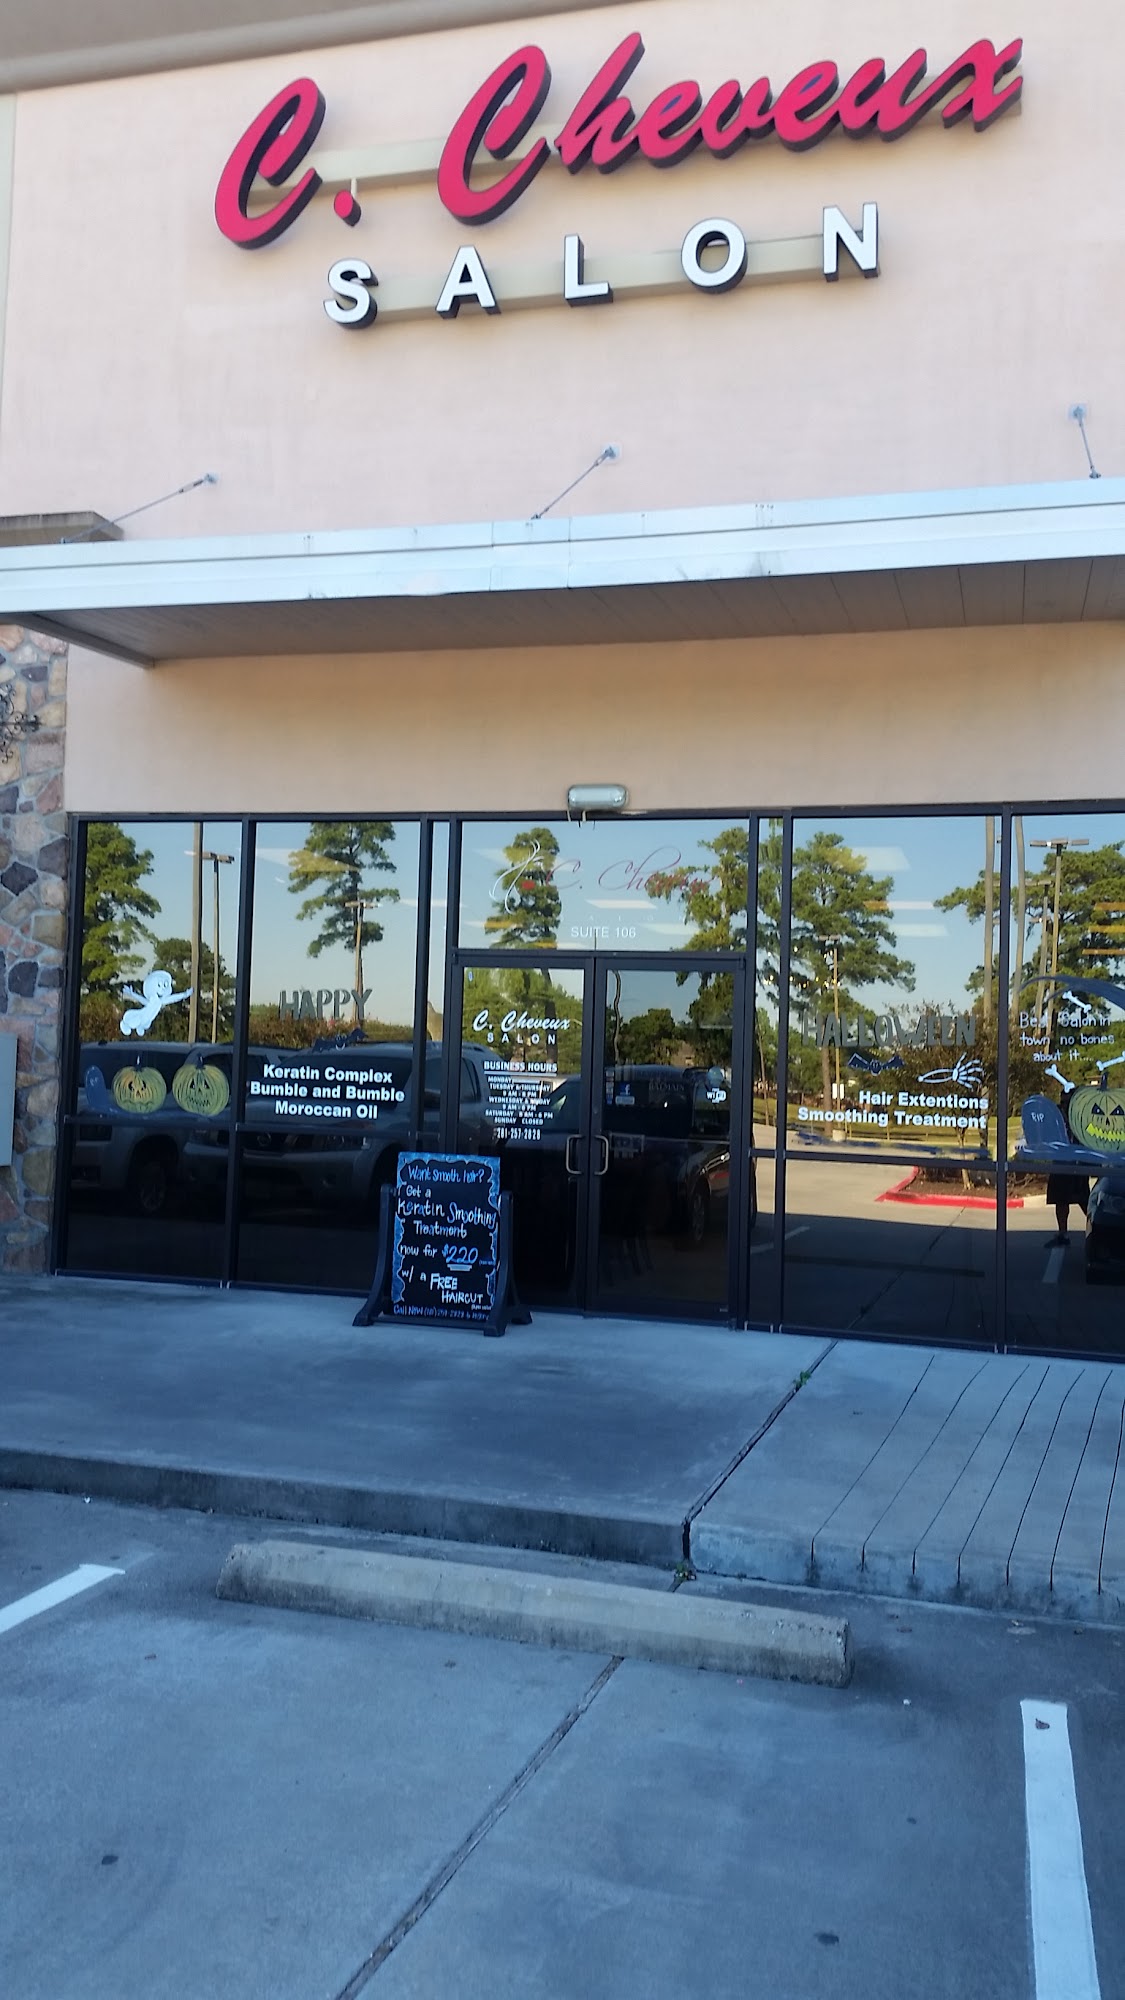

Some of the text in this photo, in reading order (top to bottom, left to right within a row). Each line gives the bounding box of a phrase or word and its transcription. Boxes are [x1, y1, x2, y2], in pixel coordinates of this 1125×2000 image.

[214, 32, 1024, 250] C. Cheveux
[323, 202, 880, 329] SALON
[598, 846, 714, 893] Chev
[570, 926, 637, 939] SUITE 106
[279, 988, 373, 1020] HAPPY
[473, 1009, 570, 1032] C. Cheveux
[801, 1010, 977, 1047] HALLOWEEN
[1099, 1013, 1111, 1027] in
[487, 1032, 556, 1045] SALON
[1060, 1035, 1075, 1046] no
[1080, 1033, 1115, 1046] bones
[1033, 1049, 1062, 1062] about
[263, 1064, 393, 1085] Keratin Complex
[484, 1061, 558, 1072] BUSINESS HOURS
[250, 1080, 405, 1102] Bumble and Bumble
[858, 1090, 989, 1110] Hair Extentions
[275, 1100, 378, 1119] Moroccan Oil
[798, 1106, 987, 1129] Smoothing Treatment
[1031, 1112, 1045, 1123] RIP
[521, 1118, 544, 1126] CLOSED
[408, 1165, 431, 1181] Want
[425, 1188, 432, 1198] a
[397, 1198, 497, 1229] Keratin Smoothing
[413, 1220, 467, 1239] Treatment
[423, 1244, 438, 1258] for
[442, 1243, 478, 1264] $220
[401, 1265, 414, 1283] w/
[430, 1273, 458, 1290] FREE
[441, 1290, 483, 1304] HAIRCUT
